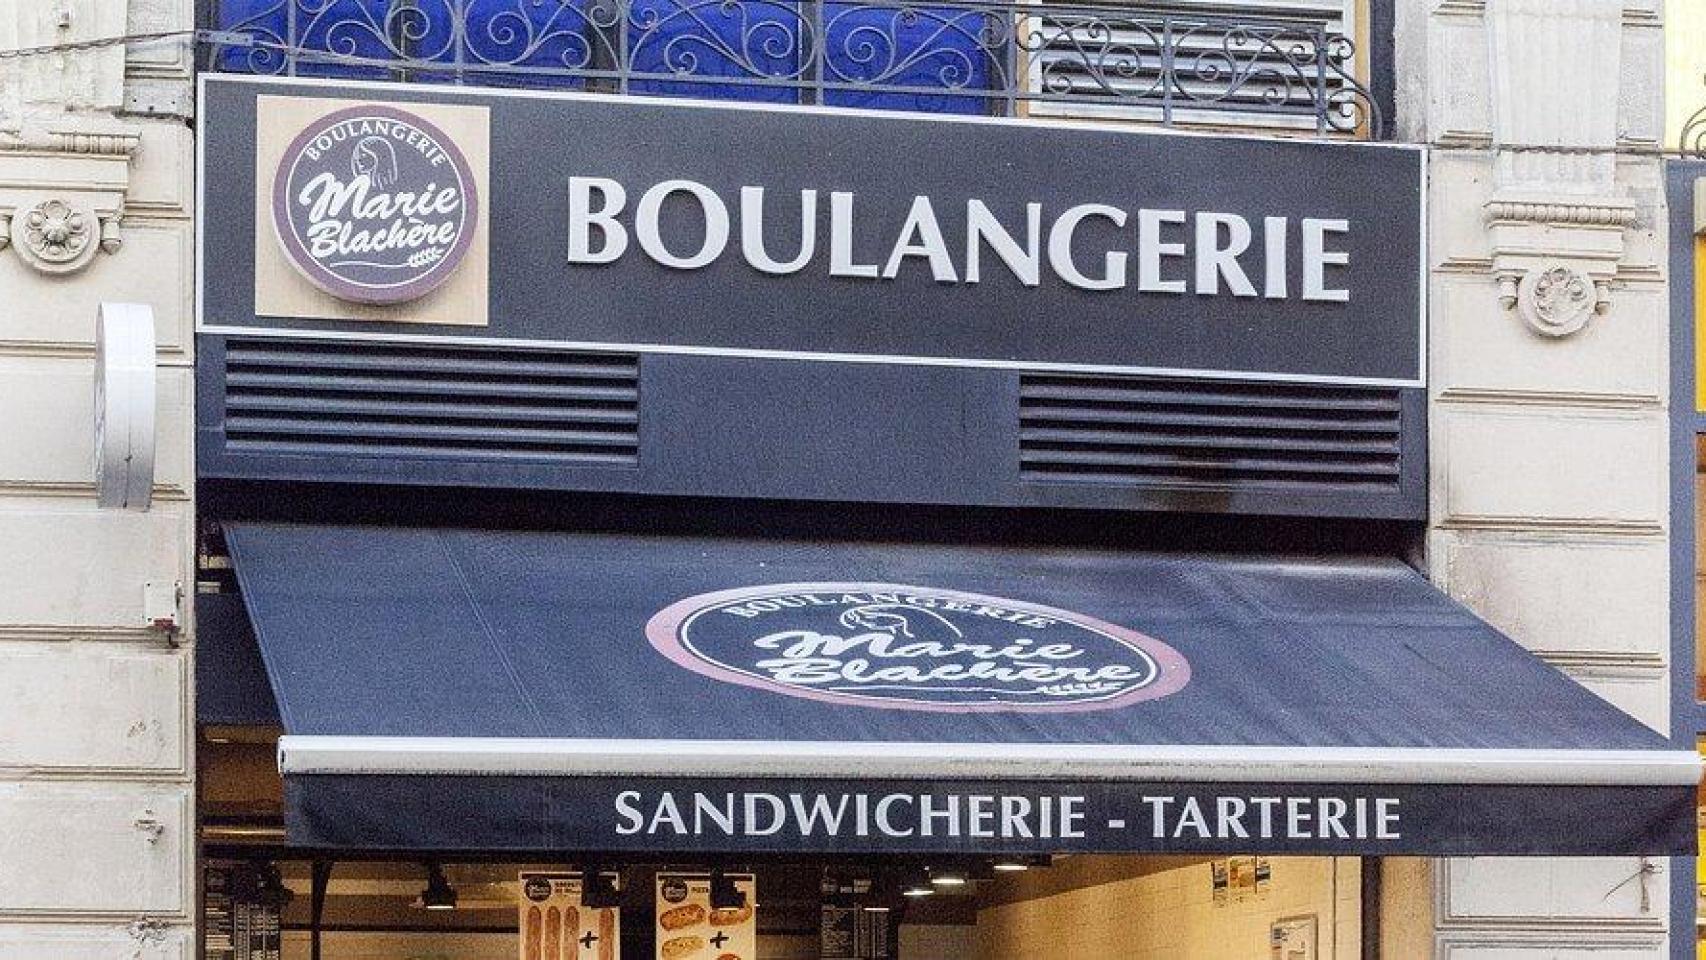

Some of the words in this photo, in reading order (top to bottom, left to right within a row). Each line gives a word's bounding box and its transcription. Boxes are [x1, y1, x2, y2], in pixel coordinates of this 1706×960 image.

[306, 120, 447, 167] BOULANGERIE
[299, 172, 459, 223] Marie
[307, 218, 455, 258] Blachère
[567, 175, 1350, 301] BOULANGERIE
[754, 630, 1084, 659] Marie
[755, 657, 1141, 684] Blachère
[614, 790, 1086, 838] SANDWICHERIE
[1142, 796, 1402, 840] TARTERIE
